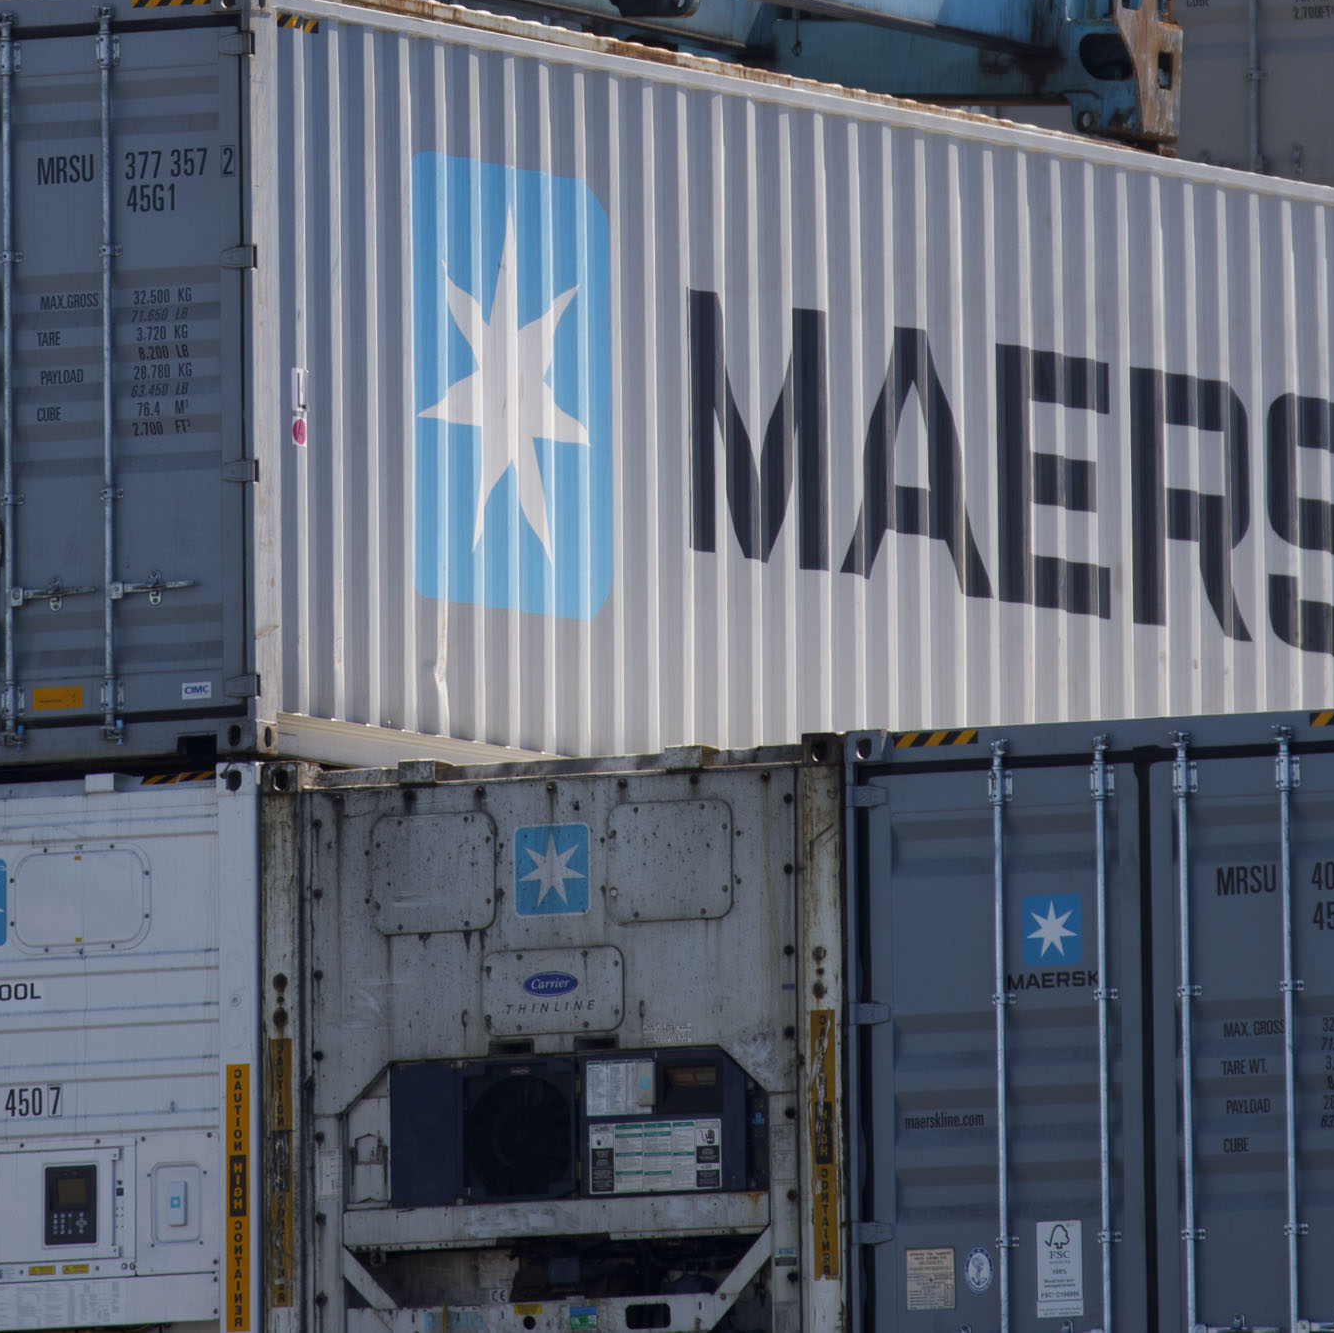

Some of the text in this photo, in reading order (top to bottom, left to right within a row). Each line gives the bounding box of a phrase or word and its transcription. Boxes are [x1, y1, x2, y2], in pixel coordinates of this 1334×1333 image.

[37, 147, 208, 186] MRSU 377 357
[126, 183, 176, 213] 45G1
[40, 287, 192, 311] MAX.GROSS 32.500 KG
[131, 306, 189, 323] 71.650 LB
[37, 324, 188, 347] TARE 3.720 KG
[138, 344, 190, 361] 8.200 LB
[40, 362, 193, 385] PAYLOAD 28.780 KG
[131, 381, 189, 399] 63.450 LB
[37, 401, 160, 422] CUBE 76.4
[132, 421, 164, 437] 2.700
[184, 684, 209, 695] CIMC
[1217, 864, 1276, 897] MRSU
[531, 977, 571, 991] Carrier
[1008, 970, 1099, 991] MAERSK
[507, 999, 595, 1014] THINLINE
[1224, 1022, 1252, 1037] MAX.
[1254, 1019, 1285, 1035] GROSS
[1221, 1058, 1268, 1075] TARE WT.
[5, 1087, 43, 1117] 450
[49, 1086, 61, 1115] 7
[1227, 1098, 1270, 1114] PAYLOAD
[904, 1111, 985, 1131] maerskline.com
[1223, 1137, 1250, 1153] CUBE
[1050, 1250, 1070, 1259] FSC
